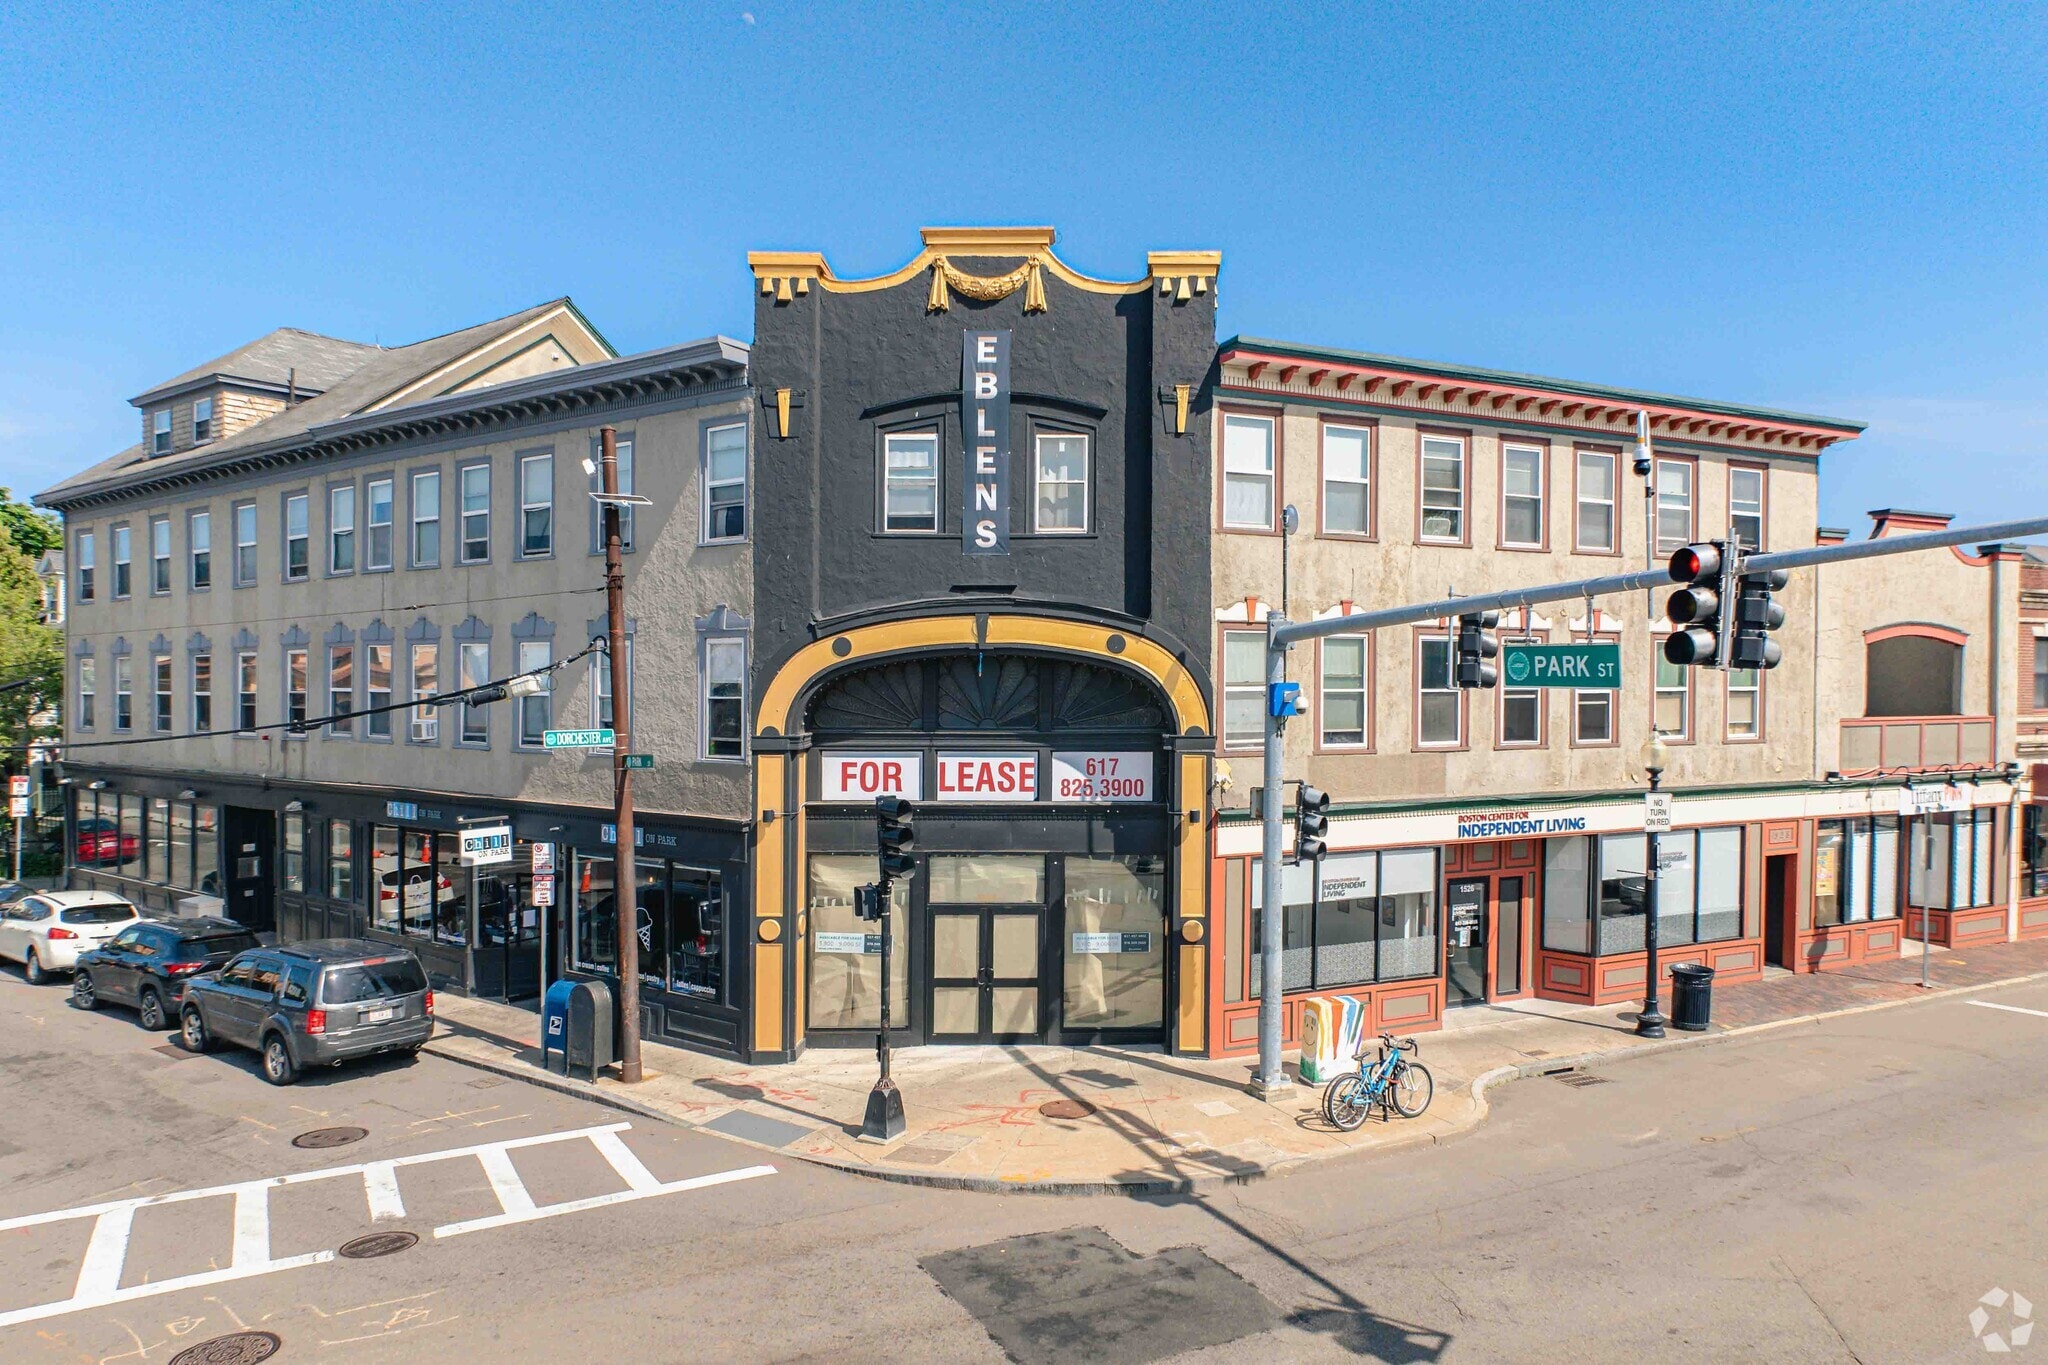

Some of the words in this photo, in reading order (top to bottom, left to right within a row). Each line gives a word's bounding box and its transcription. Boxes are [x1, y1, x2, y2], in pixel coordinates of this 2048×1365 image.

[974, 336, 998, 548] EBLENS
[1534, 655, 1590, 677] PARK
[1598, 663, 1614, 677] ST
[557, 732, 601, 745] DORCHESTER
[1086, 758, 1119, 776] 617
[841, 762, 903, 792] FOR
[939, 762, 1034, 792] LEASE
[1060, 778, 1144, 797] 825.3900
[387, 801, 417, 819] Chill
[1653, 799, 1663, 807] NO
[1458, 814, 1487, 823] BOSTON
[1488, 812, 1514, 821] CENTER
[1515, 811, 1529, 820] FOR
[1646, 818, 1656, 826] ON
[1656, 818, 1670, 826] RED
[601, 825, 642, 845] Chl
[645, 834, 655, 843] ON
[657, 835, 677, 846] PARK
[1458, 819, 1544, 838] INDEPENDENT
[1547, 817, 1586, 832] LIVING
[465, 835, 509, 852] Chill
[478, 849, 488, 858] ON
[490, 847, 509, 856] PARK
